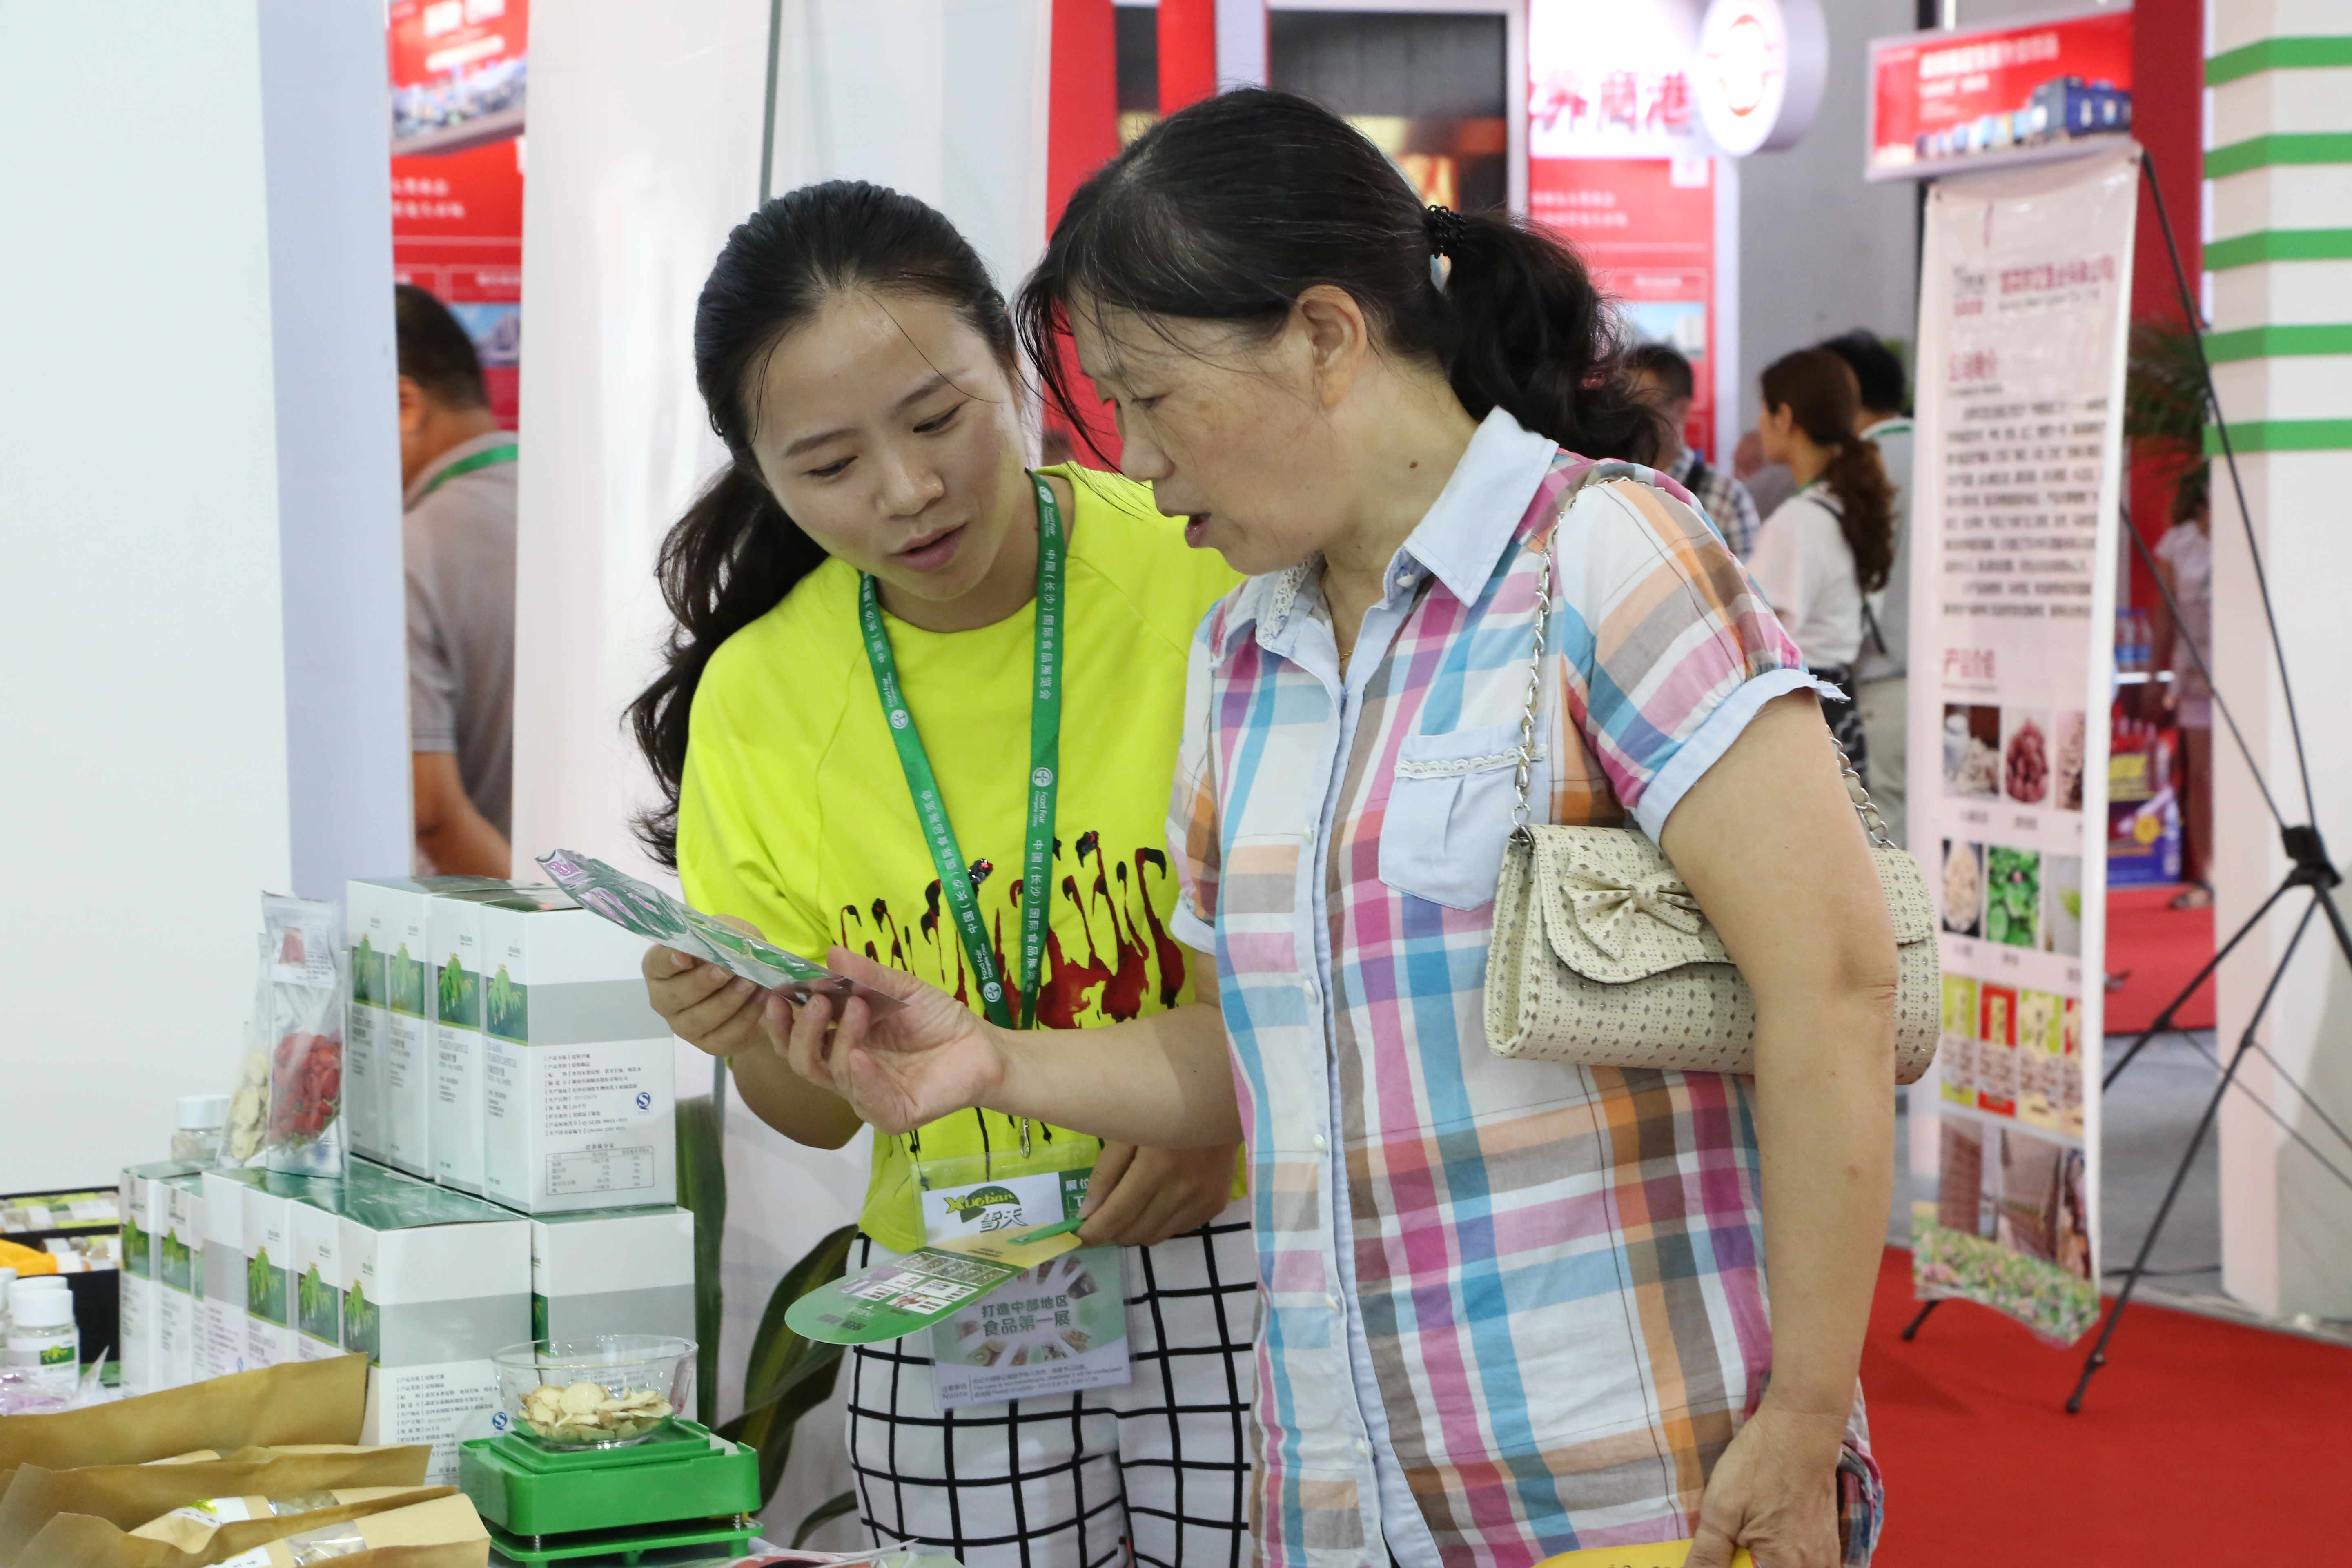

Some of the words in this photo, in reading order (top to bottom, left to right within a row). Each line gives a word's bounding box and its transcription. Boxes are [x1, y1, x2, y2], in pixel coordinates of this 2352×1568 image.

[981, 1294, 1069, 1318] 打造中部地区
[983, 1310, 1070, 1336] 食品第一展
